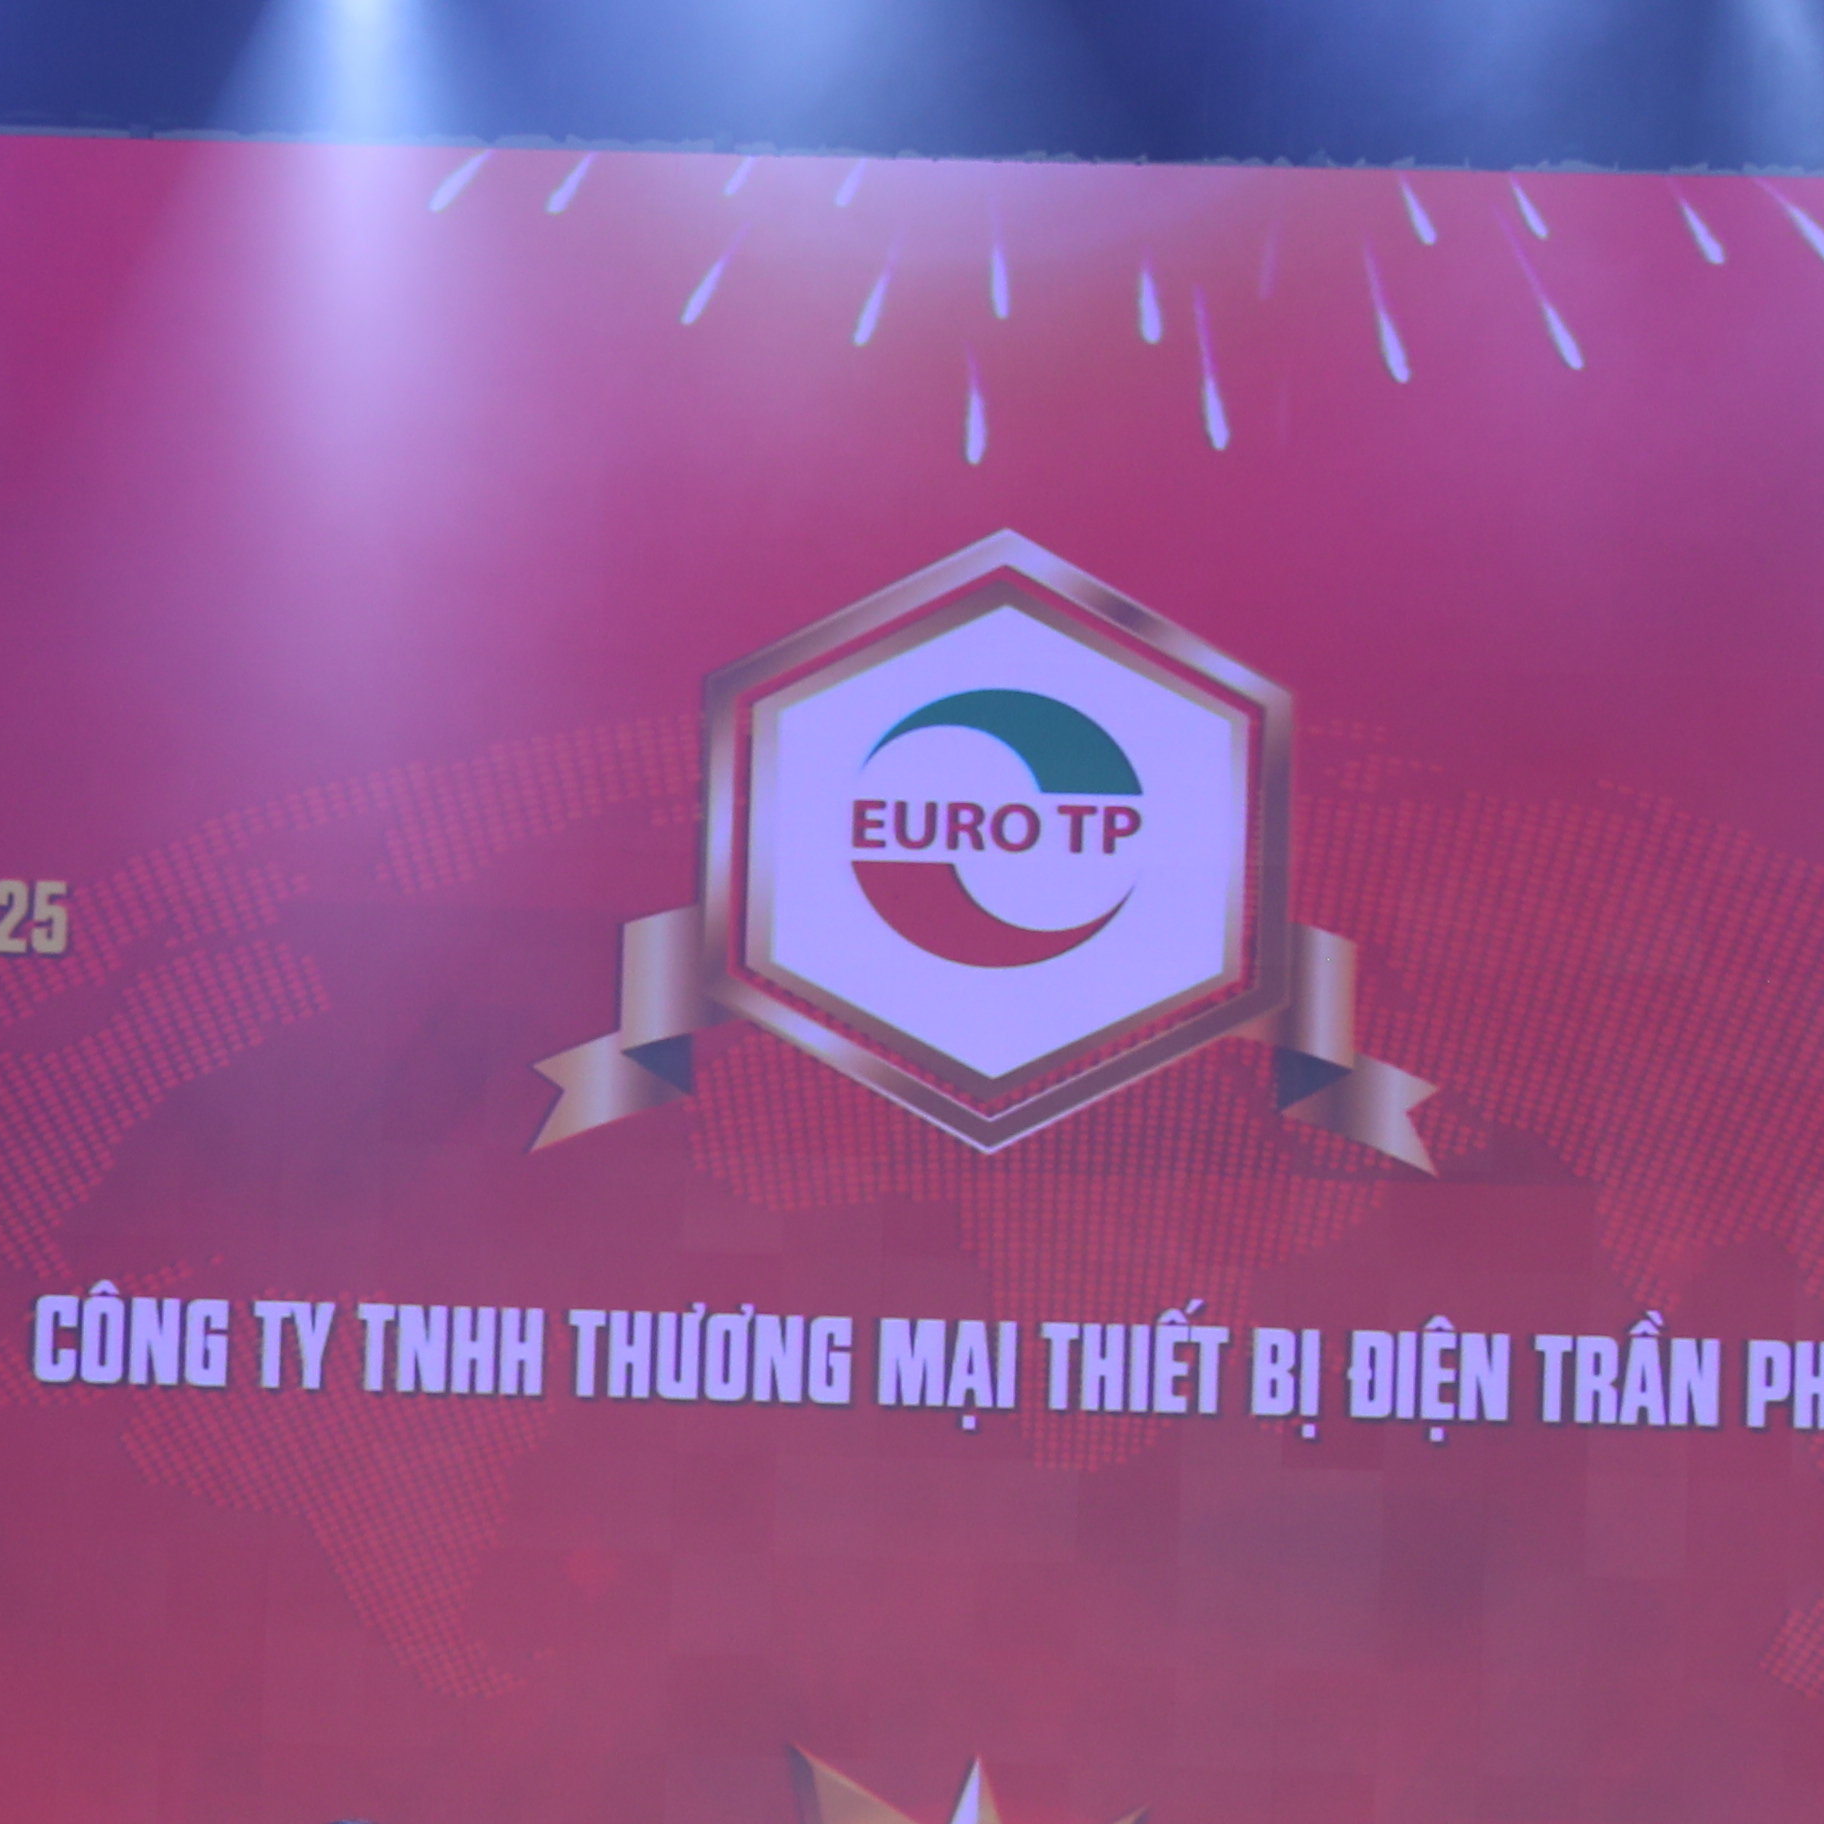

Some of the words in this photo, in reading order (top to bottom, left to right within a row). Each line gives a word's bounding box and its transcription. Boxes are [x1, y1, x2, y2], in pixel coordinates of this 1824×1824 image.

[851, 799, 1041, 853] EURO
[1057, 804, 1142, 854] TP
[33, 1279, 230, 1388] CÔNG
[254, 1300, 336, 1390] TY
[357, 1302, 545, 1396] TNHH
[569, 1302, 853, 1404] THƯƠNG
[877, 1316, 1017, 1430] MẠI
[1040, 1298, 1230, 1415] THIẾT
[1251, 1326, 1321, 1440] BỊ
[1346, 1314, 1510, 1442] ĐIỆN
[1534, 1310, 1721, 1428] TRẦN
